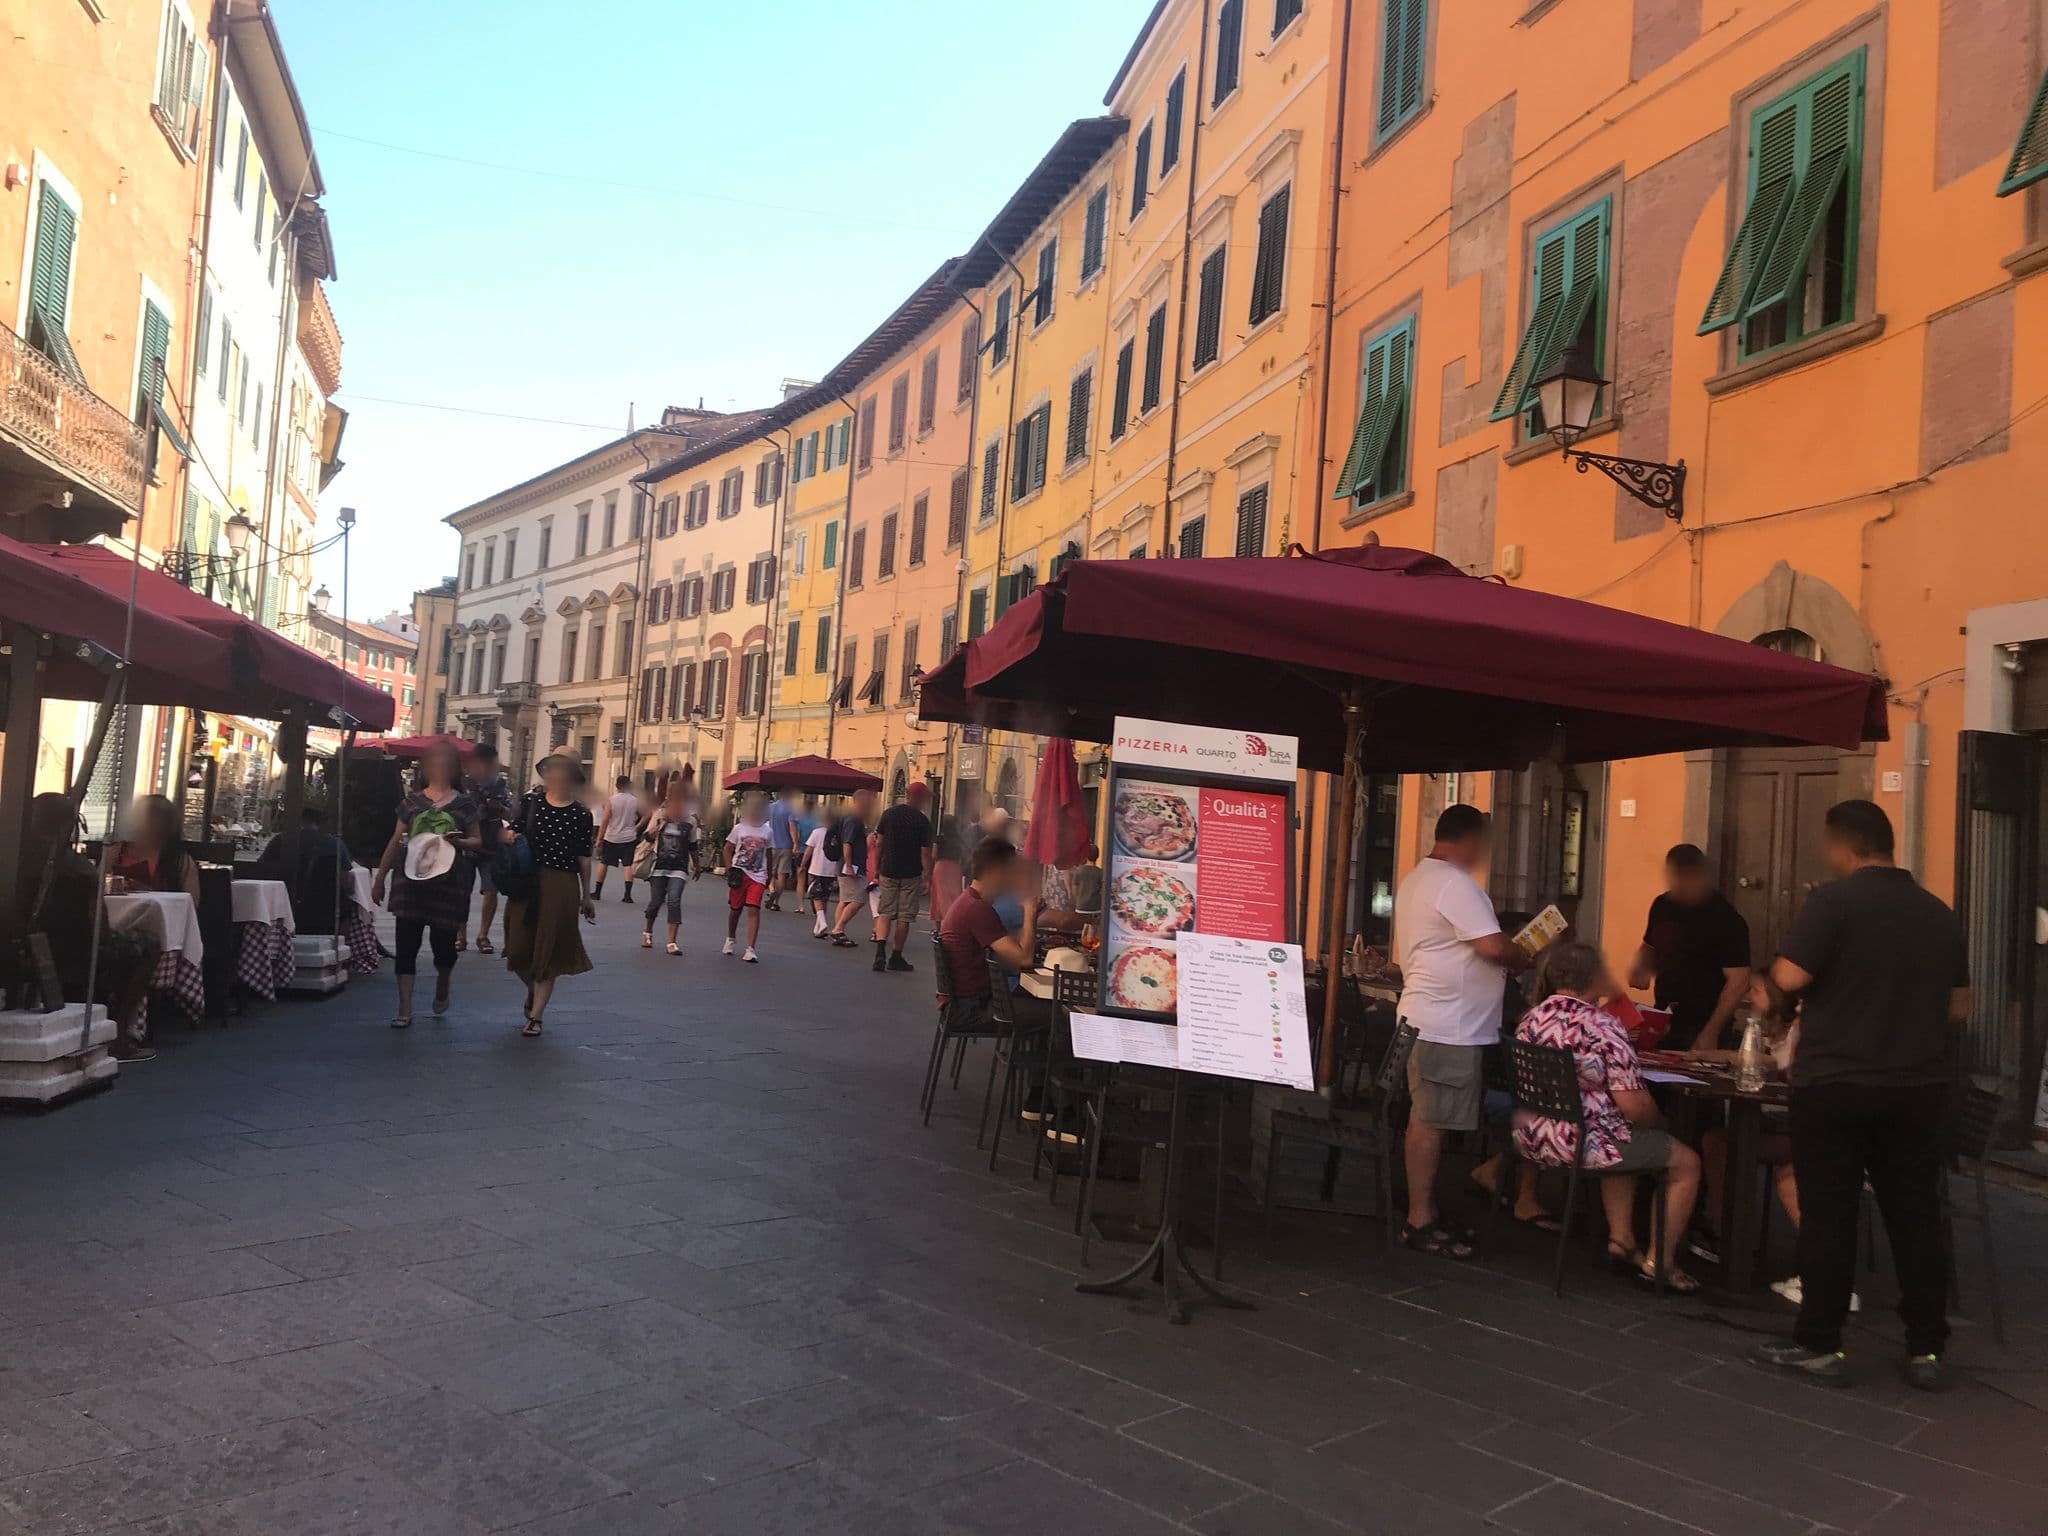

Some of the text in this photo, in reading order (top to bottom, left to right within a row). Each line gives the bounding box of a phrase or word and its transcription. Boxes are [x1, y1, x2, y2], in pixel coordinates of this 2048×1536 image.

[1117, 737, 1188, 754] PIZZERIA
[1196, 747, 1237, 759] QUARTO
[1213, 799, 1267, 818] Qualità
